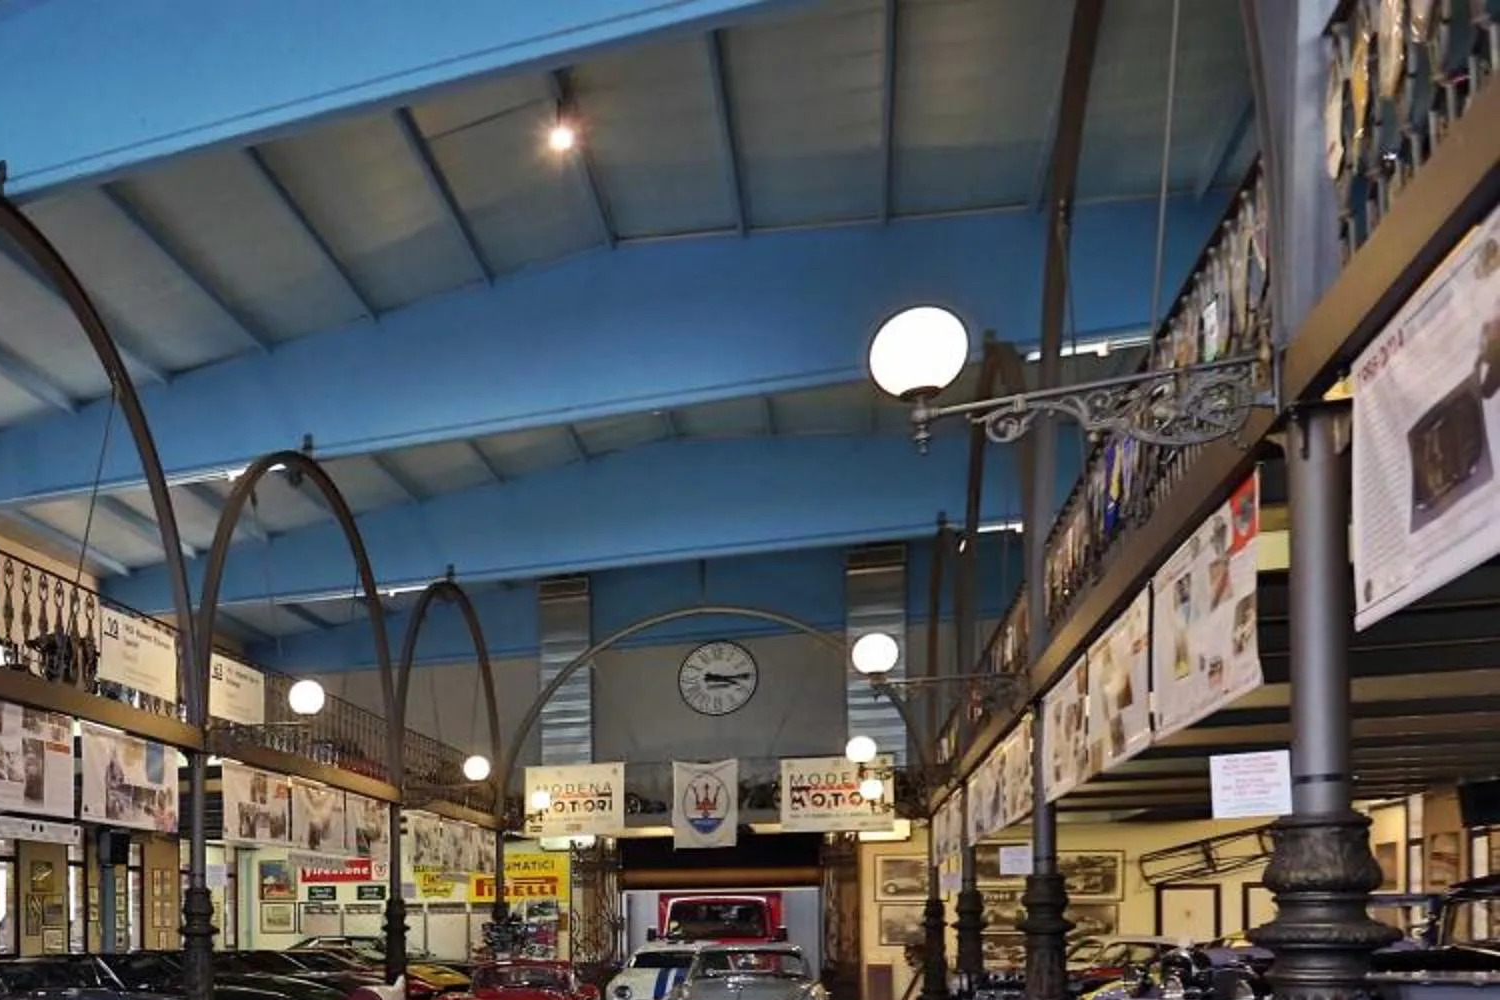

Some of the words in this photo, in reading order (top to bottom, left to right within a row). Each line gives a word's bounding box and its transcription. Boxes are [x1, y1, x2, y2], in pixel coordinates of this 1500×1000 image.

[790, 772, 866, 786] MODE
[546, 800, 613, 813] OTORI
[791, 791, 865, 808] MOTO
